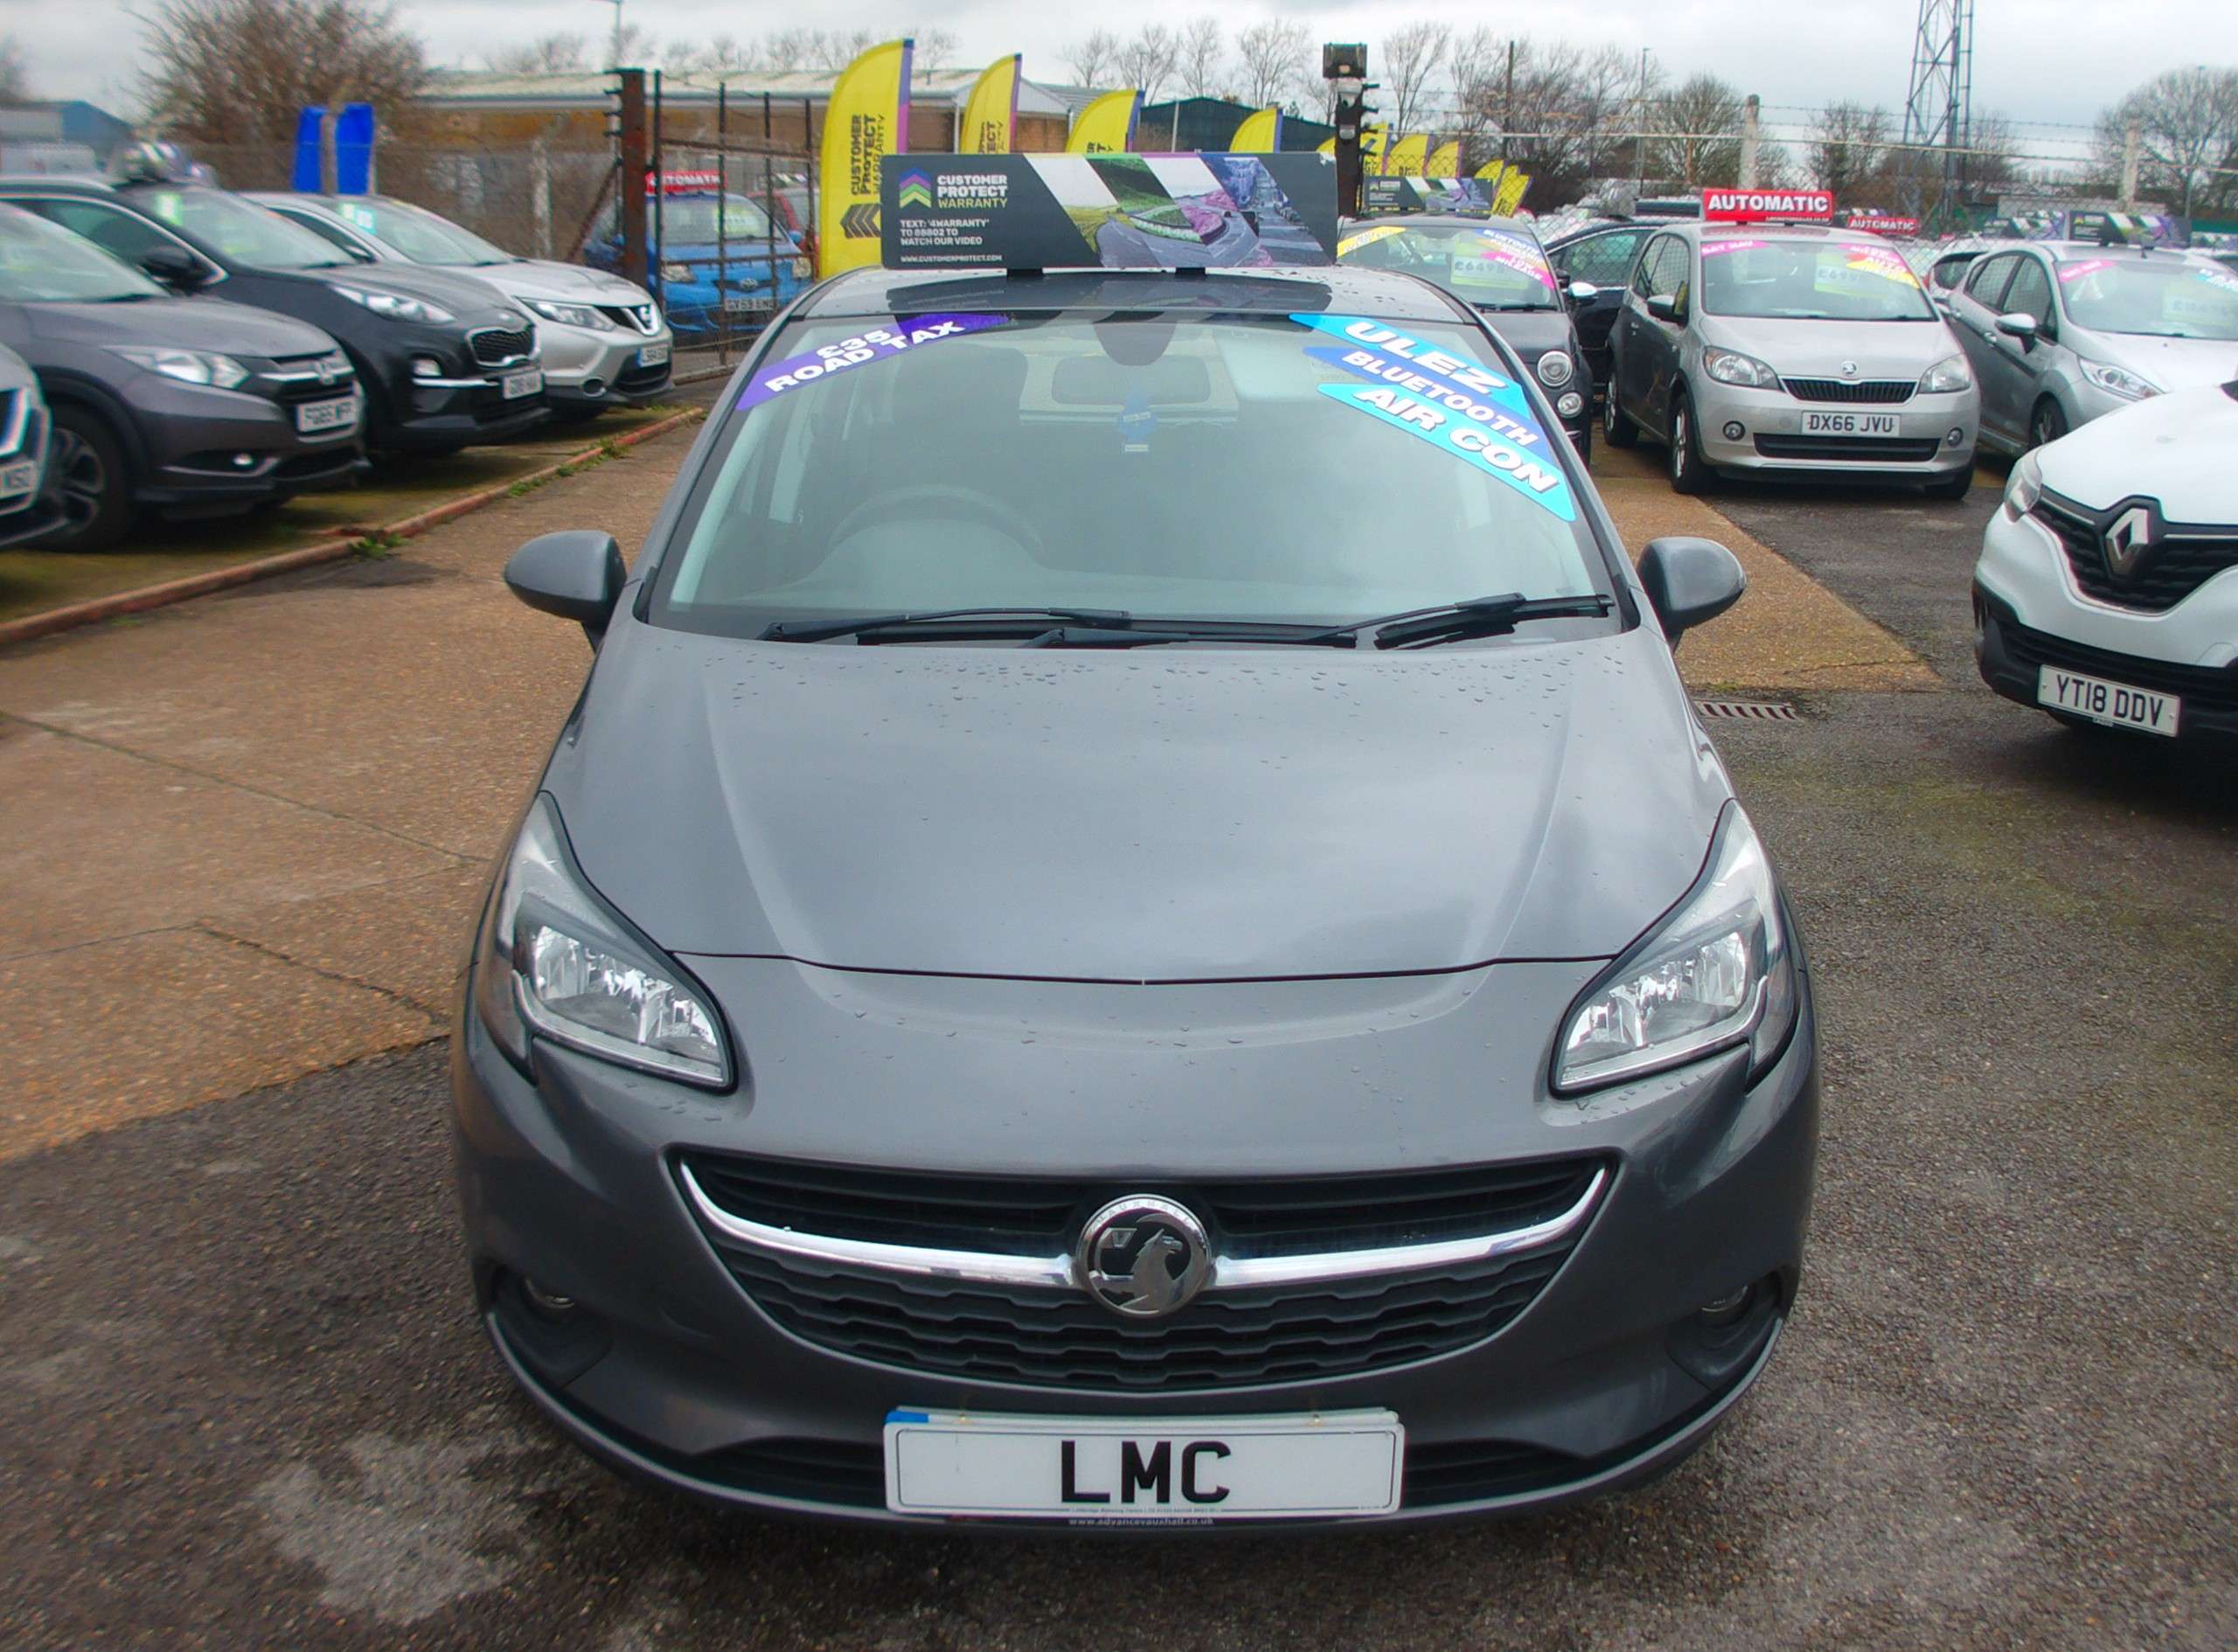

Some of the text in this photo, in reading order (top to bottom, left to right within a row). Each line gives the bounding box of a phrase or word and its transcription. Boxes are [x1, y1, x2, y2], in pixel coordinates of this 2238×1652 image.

[851, 114, 862, 195] CUSTOMER
[860, 114, 876, 195] PROTECT
[937, 175, 1007, 185] CUSTOMER
[937, 186, 1007, 198] PROTECT
[937, 198, 1008, 209] WARRANTY
[1707, 194, 1829, 212] AUTOMATIC
[900, 219, 927, 228] TEXT:
[1850, 219, 1915, 231] AUTOMATIC
[956, 236, 983, 245] VIDEO
[765, 321, 966, 392] ROAD TAX
[816, 330, 892, 359] £35
[1345, 322, 1507, 395] ULEZ
[1342, 351, 1539, 447] BLUETOOTH
[1809, 414, 1894, 433] DX66 JVU
[1353, 388, 1560, 495] AIR CON
[2056, 673, 2164, 727] YT18 DDV
[1060, 1440, 1231, 1504] LMC
[1068, 1517, 1214, 1527] www.advancevauxhall.co.uk
